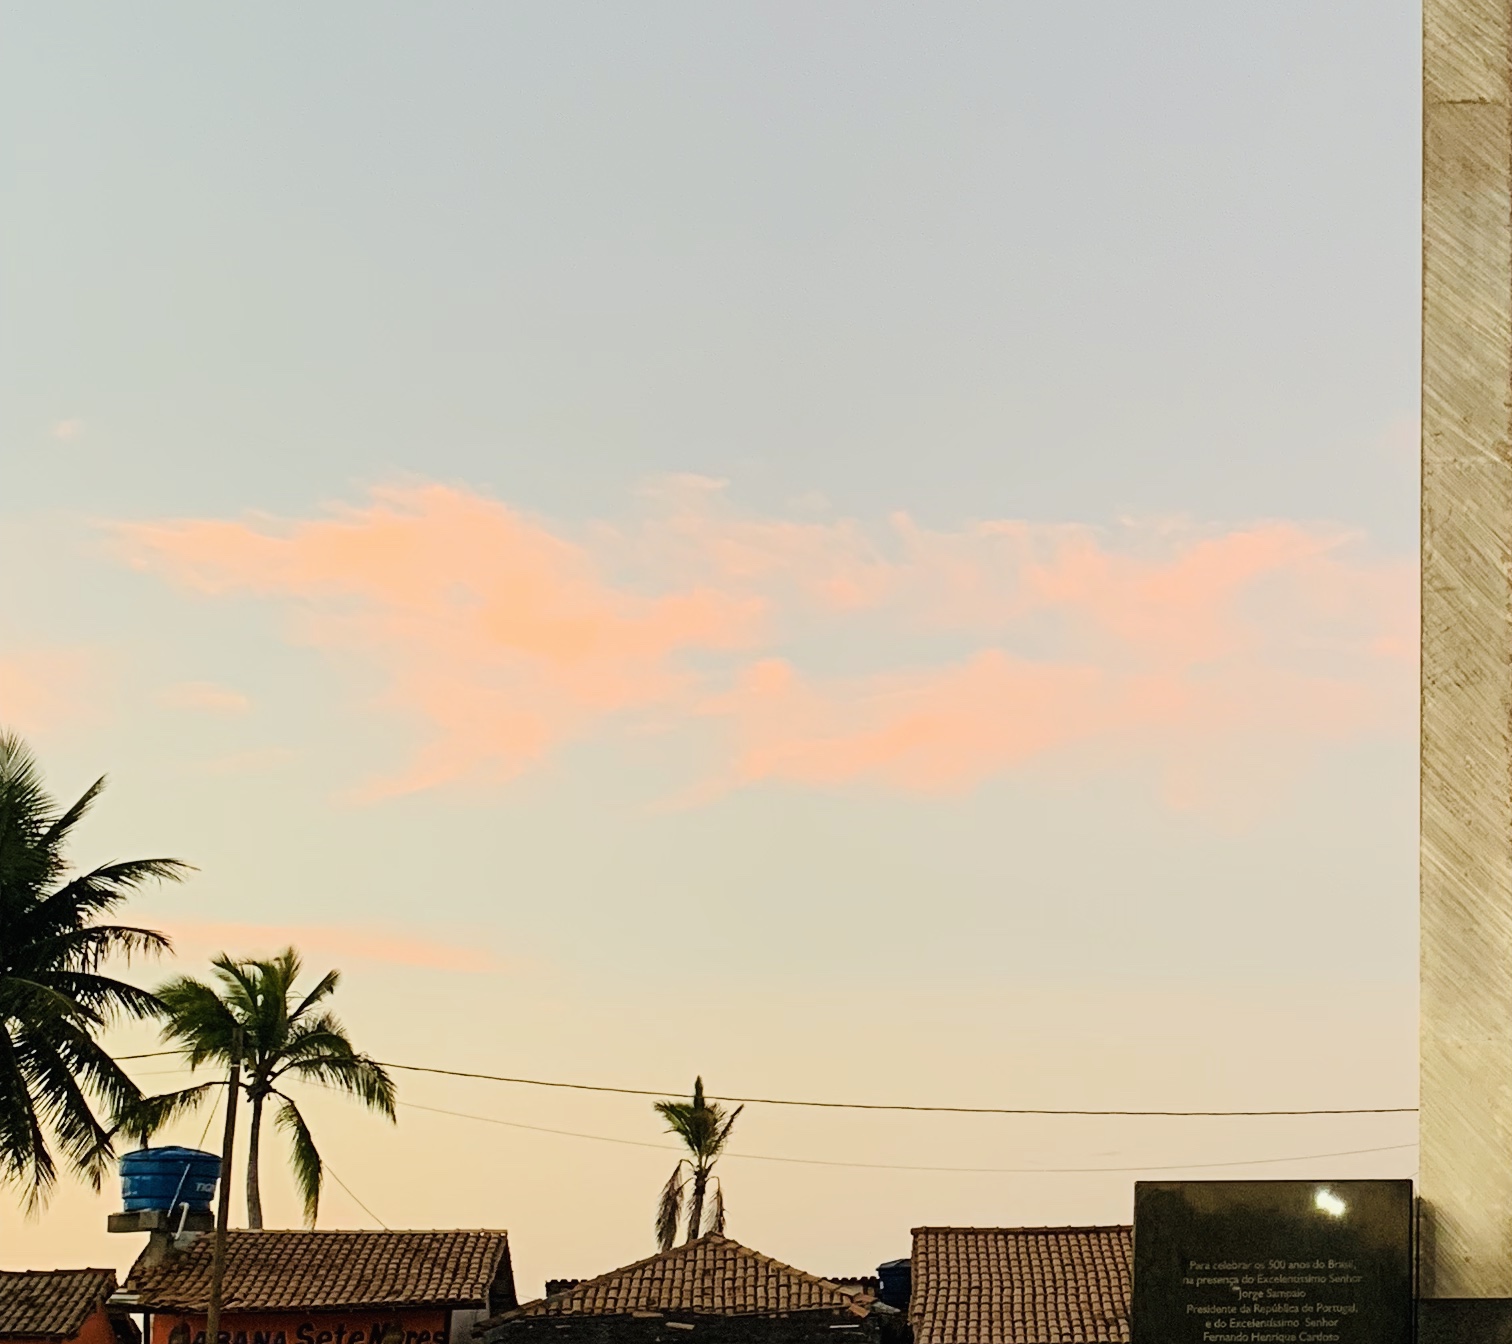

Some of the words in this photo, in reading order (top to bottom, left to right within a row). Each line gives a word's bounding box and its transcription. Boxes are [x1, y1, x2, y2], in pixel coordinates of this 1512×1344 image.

[1189, 1261, 1210, 1270] Para
[1212, 1261, 1251, 1270] celebrar
[1268, 1260, 1286, 1270] 500
[1312, 1259, 1326, 1269] do
[1182, 1276, 1194, 1284] na
[1196, 1275, 1239, 1287] presença
[1241, 1274, 1254, 1284] do
[1328, 1273, 1363, 1283] Senhor
[1238, 1289, 1264, 1301] Jorge
[1266, 1288, 1306, 1299] Sampaio
[1186, 1304, 1237, 1314] Presidente
[1239, 1304, 1251, 1314] da
[1301, 1304, 1314, 1313] de
[1213, 1319, 1227, 1328] do
[1305, 1317, 1339, 1327] Senhor
[1202, 1332, 1249, 1342] Fernando
[1251, 1333, 1296, 1343] Henrique
[1298, 1331, 1340, 1342] Cardoso
